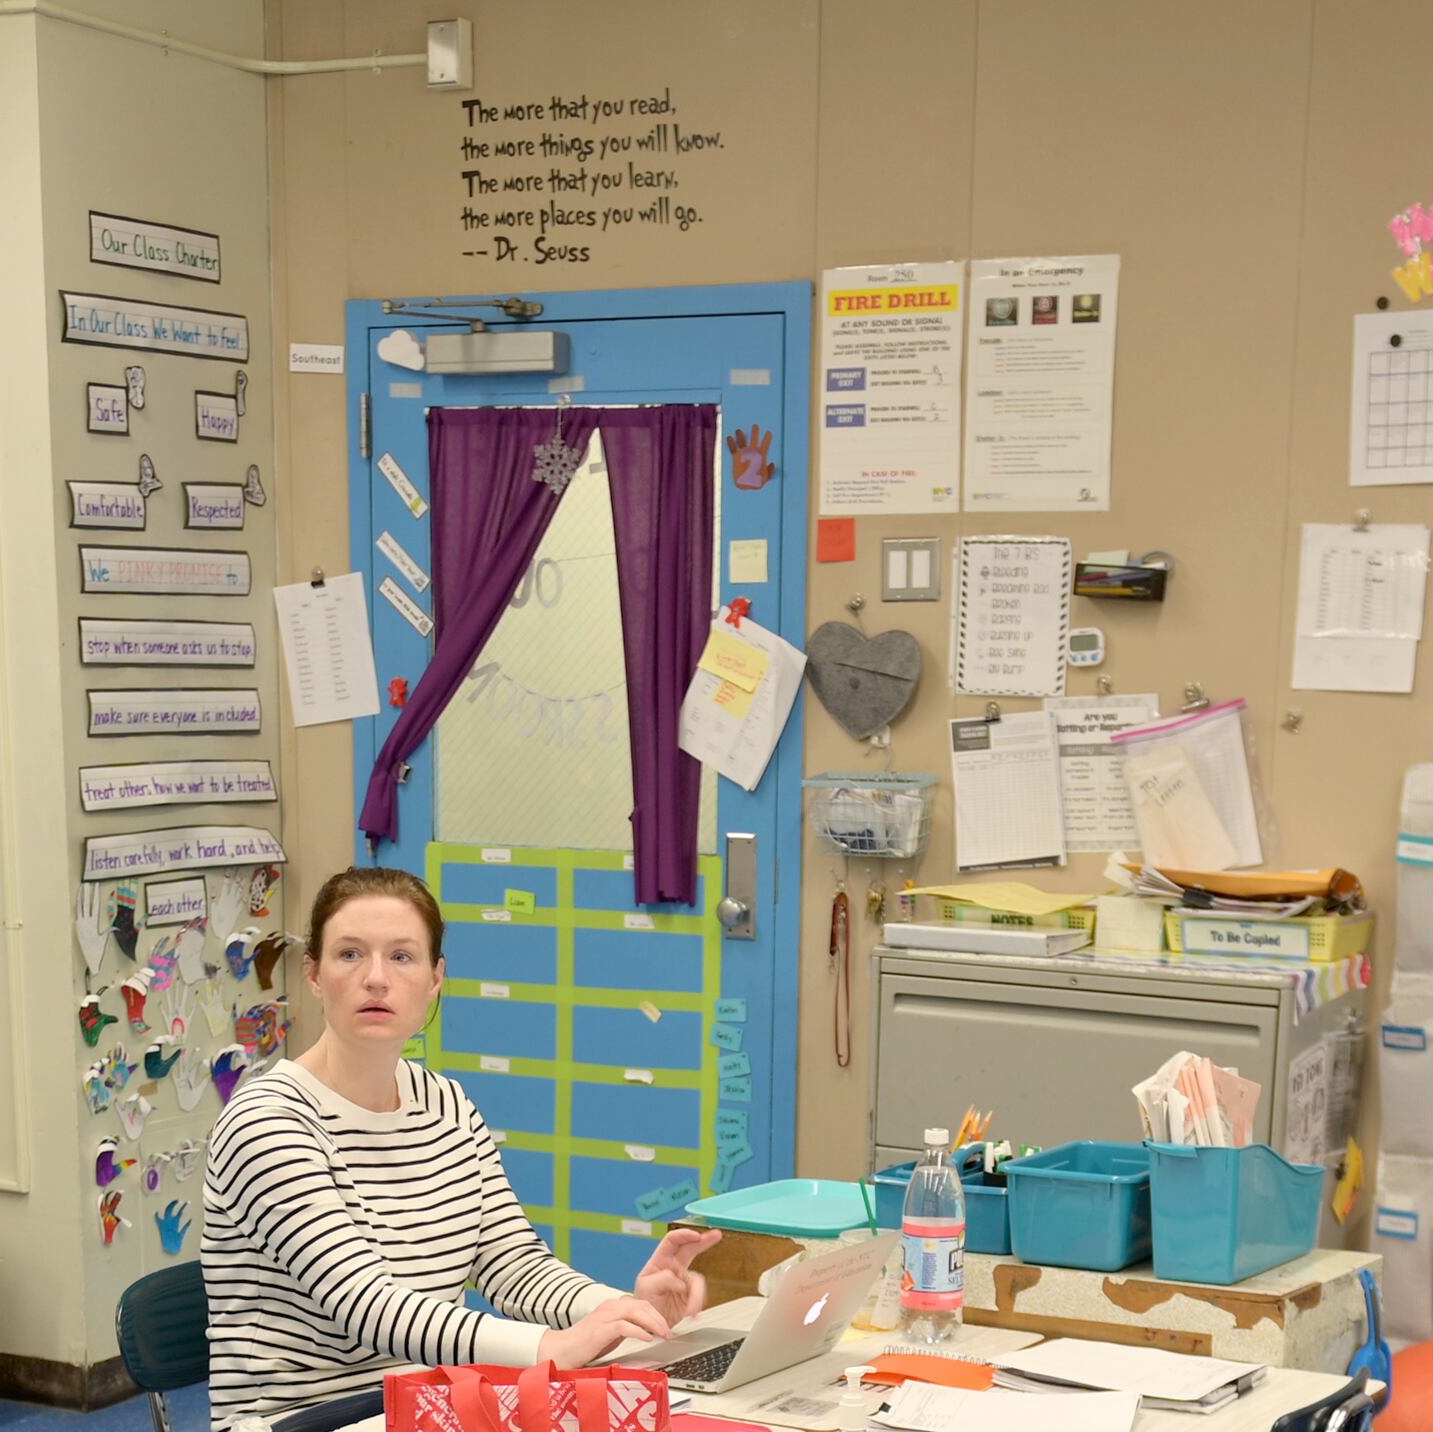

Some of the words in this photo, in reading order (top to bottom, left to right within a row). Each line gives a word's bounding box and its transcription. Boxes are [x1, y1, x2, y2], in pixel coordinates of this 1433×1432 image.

[462, 100, 499, 127] The
[549, 95, 588, 121] that
[593, 100, 623, 124] you
[630, 87, 676, 116] read,
[461, 136, 490, 161] the
[600, 136, 631, 160] you
[636, 124, 668, 152] will
[461, 170, 498, 198] The
[548, 167, 587, 193] that
[591, 172, 622, 196] you
[461, 207, 490, 231] the
[540, 200, 596, 233] places
[602, 205, 633, 232] you
[638, 197, 669, 225] will
[675, 205, 703, 231] go.
[102, 229, 127, 253] Our
[133, 235, 169, 261] Class
[175, 240, 217, 271] Charter
[534, 236, 590, 264] Seuss
[834, 293, 882, 311] FIRE
[887, 291, 952, 309] DRILL
[291, 353, 343, 366] Southeast
[95, 400, 125, 422] Safe
[200, 407, 235, 434] Happy
[78, 494, 144, 519] Comfortable
[191, 499, 242, 520] Respected
[1210, 931, 1222, 942] To
[1227, 932, 1240, 945] Be
[1245, 933, 1281, 950] Copied
